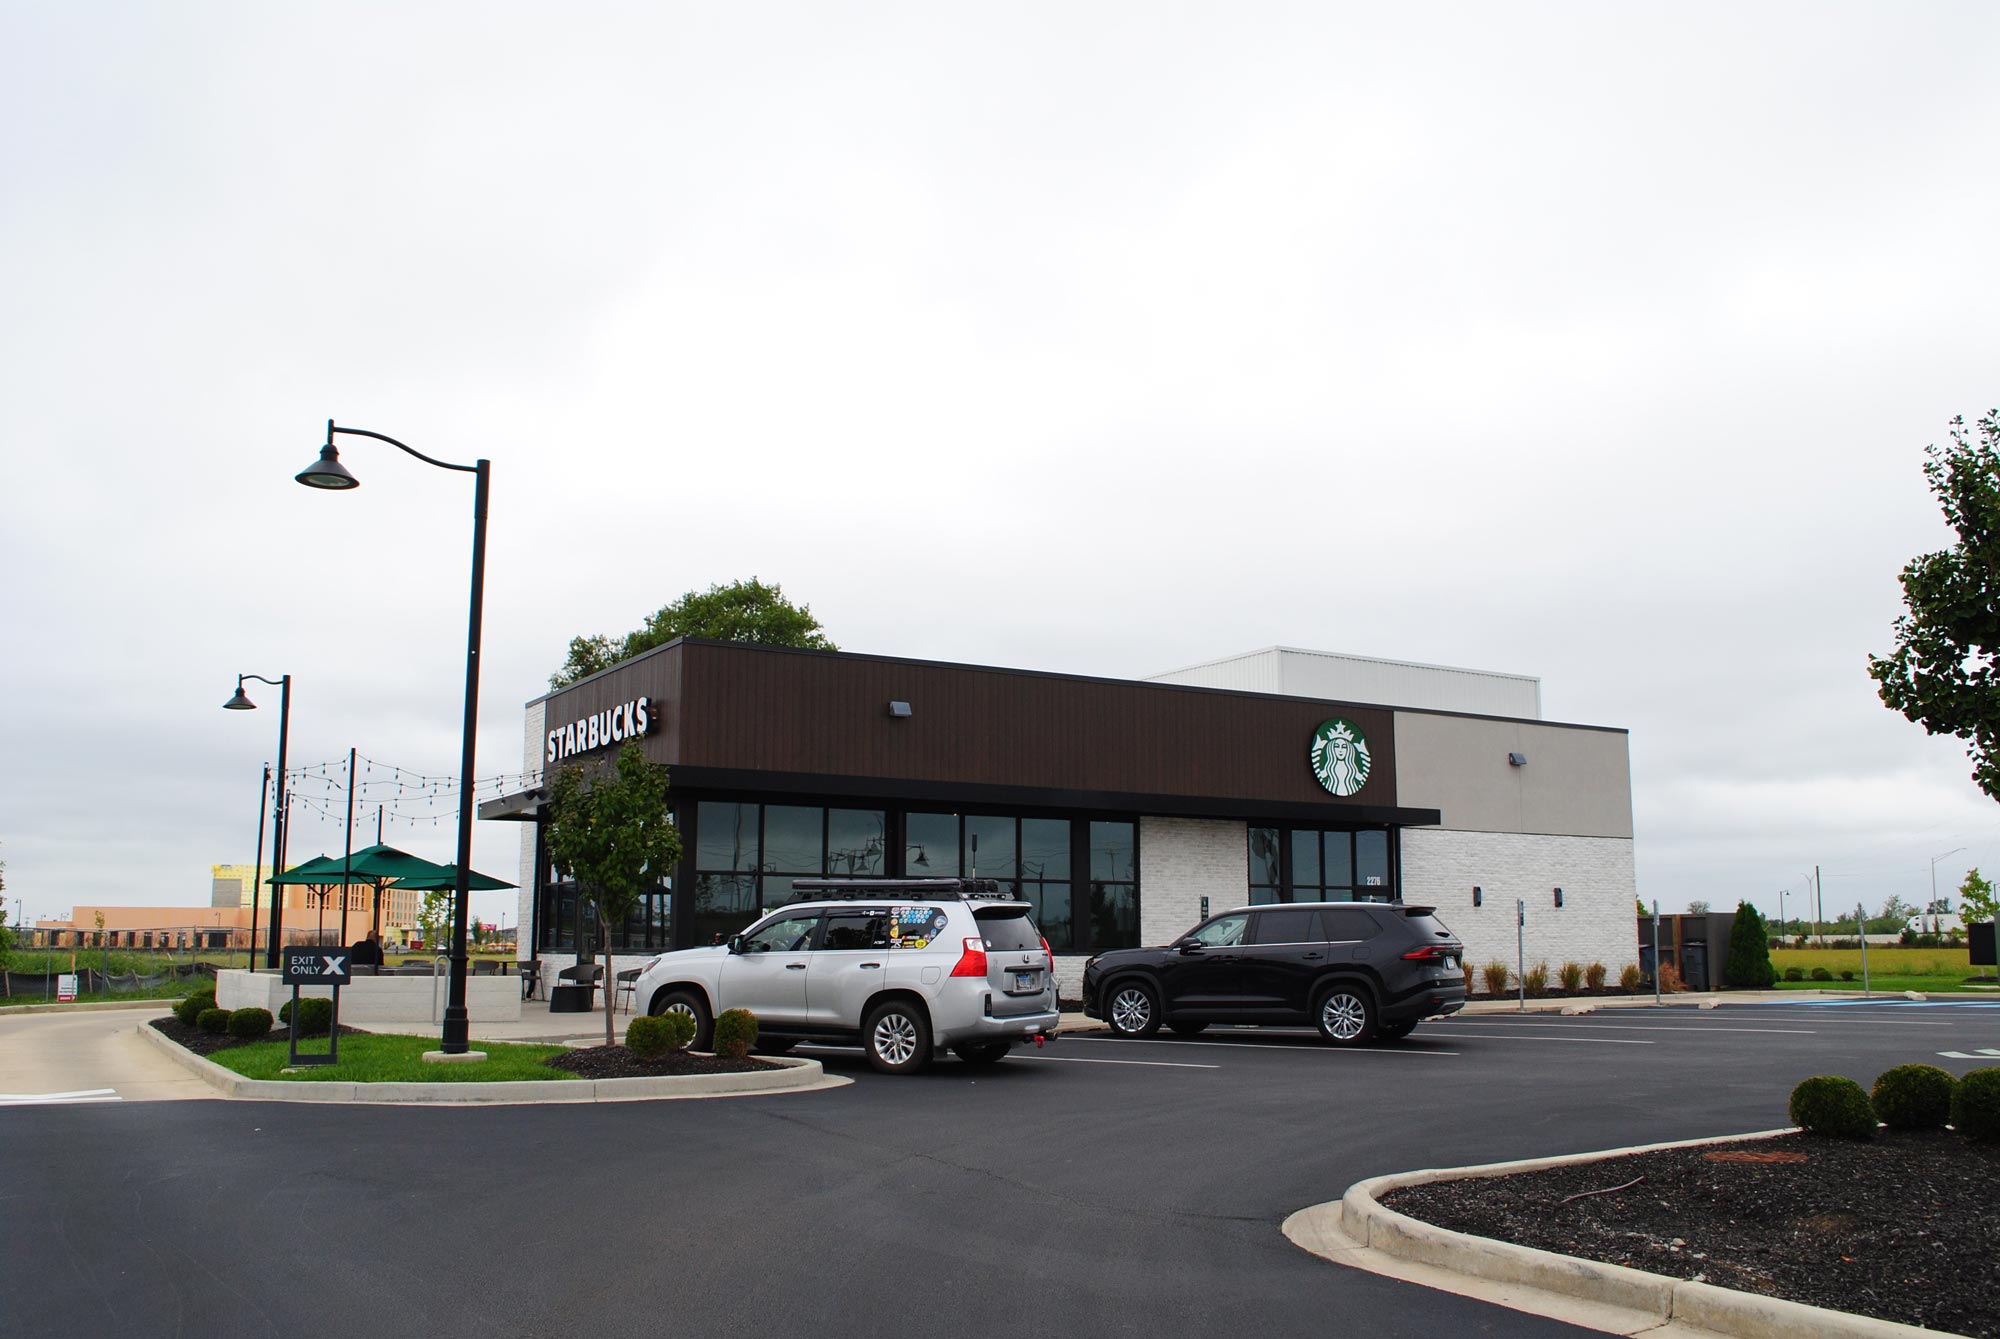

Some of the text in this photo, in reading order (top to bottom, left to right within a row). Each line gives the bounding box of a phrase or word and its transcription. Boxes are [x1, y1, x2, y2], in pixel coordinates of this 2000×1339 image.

[547, 696, 650, 763] STARBUCKS
[291, 956, 316, 965] EXIT
[291, 965, 320, 975] ONLY
